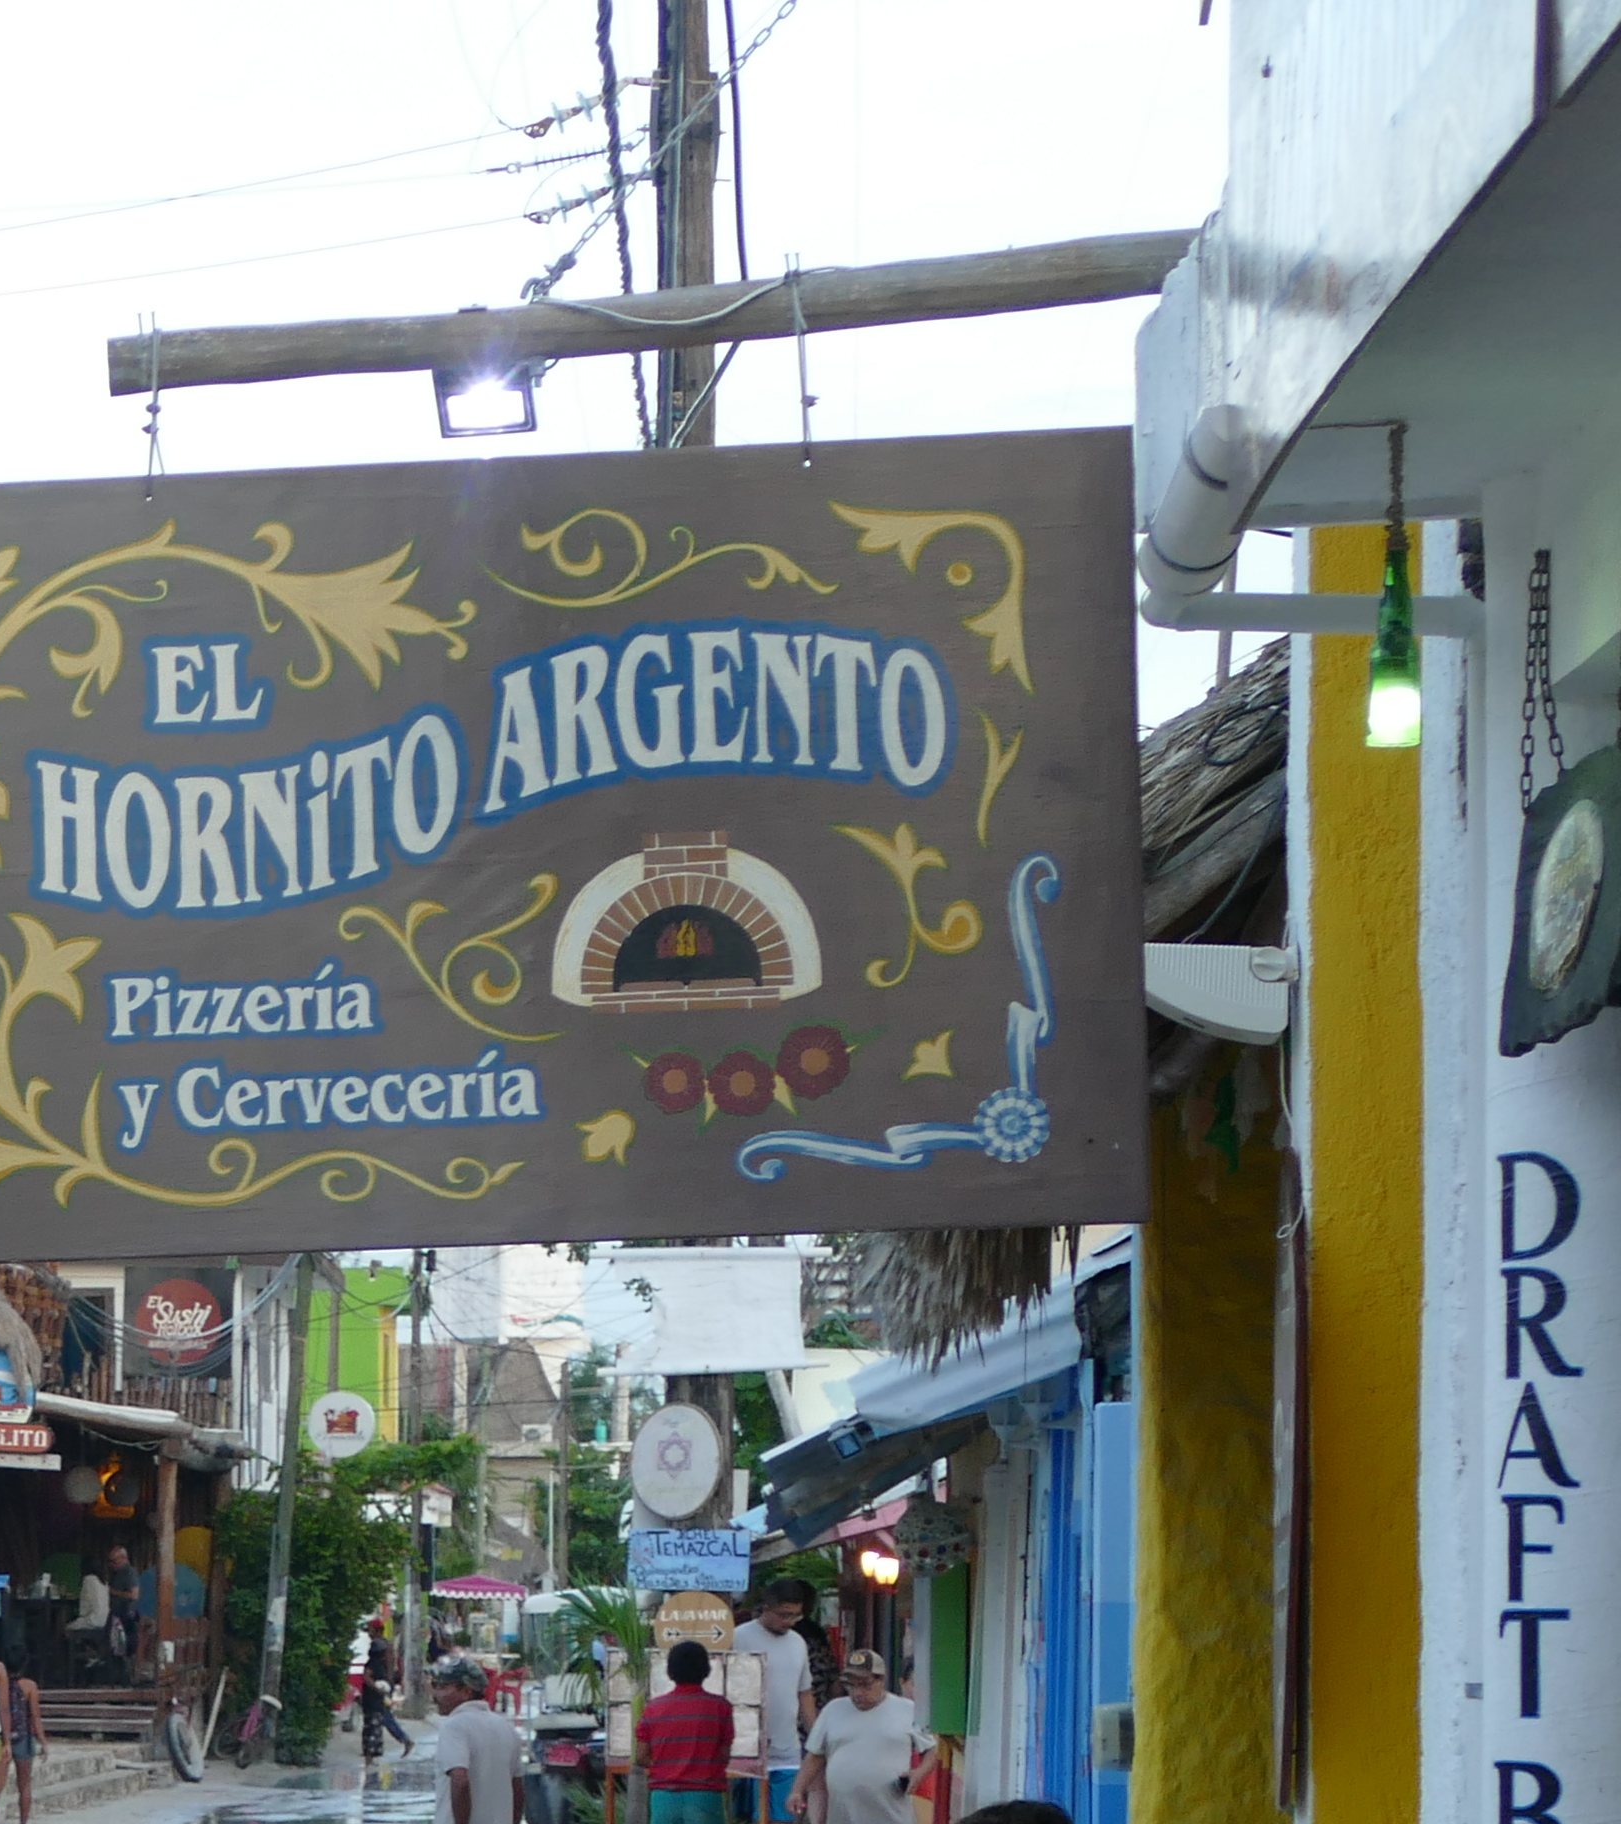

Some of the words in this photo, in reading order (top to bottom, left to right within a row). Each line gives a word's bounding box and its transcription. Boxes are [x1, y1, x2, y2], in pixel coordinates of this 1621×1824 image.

[153, 643, 265, 727] EL
[483, 627, 949, 813] ARGENTO
[108, 964, 375, 1039] Pizzería
[120, 1079, 157, 1151] y
[175, 1049, 541, 1130] Cervecería
[153, 1301, 213, 1326] Sushi
[1495, 1150, 1582, 1722] DRAFT
[647, 1530, 749, 1557] TEMAZCAL
